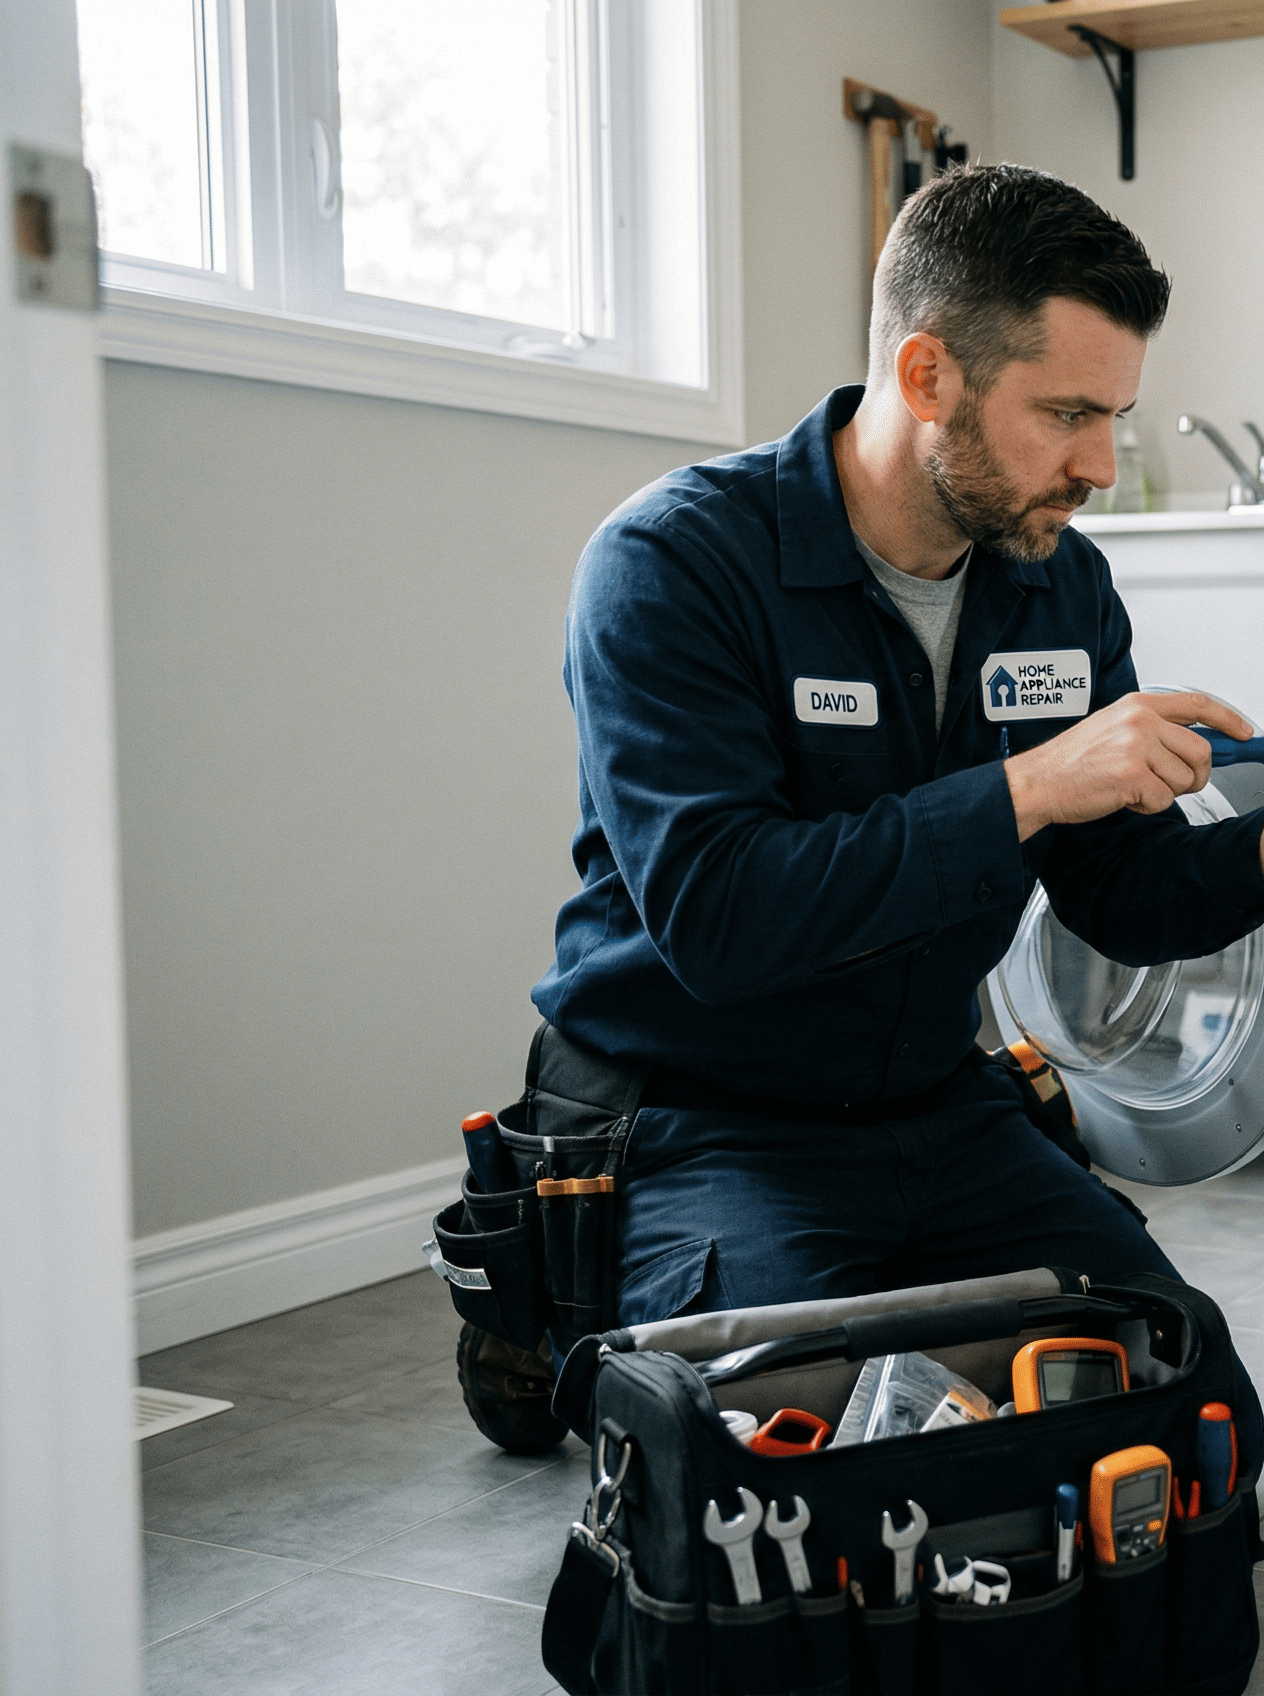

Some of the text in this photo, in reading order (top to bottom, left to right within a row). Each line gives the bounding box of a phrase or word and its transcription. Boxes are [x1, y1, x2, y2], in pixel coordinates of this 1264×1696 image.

[1018, 664, 1055, 678] HOME
[811, 691, 858, 713] DAVID
[1021, 692, 1064, 706] REPAIR
